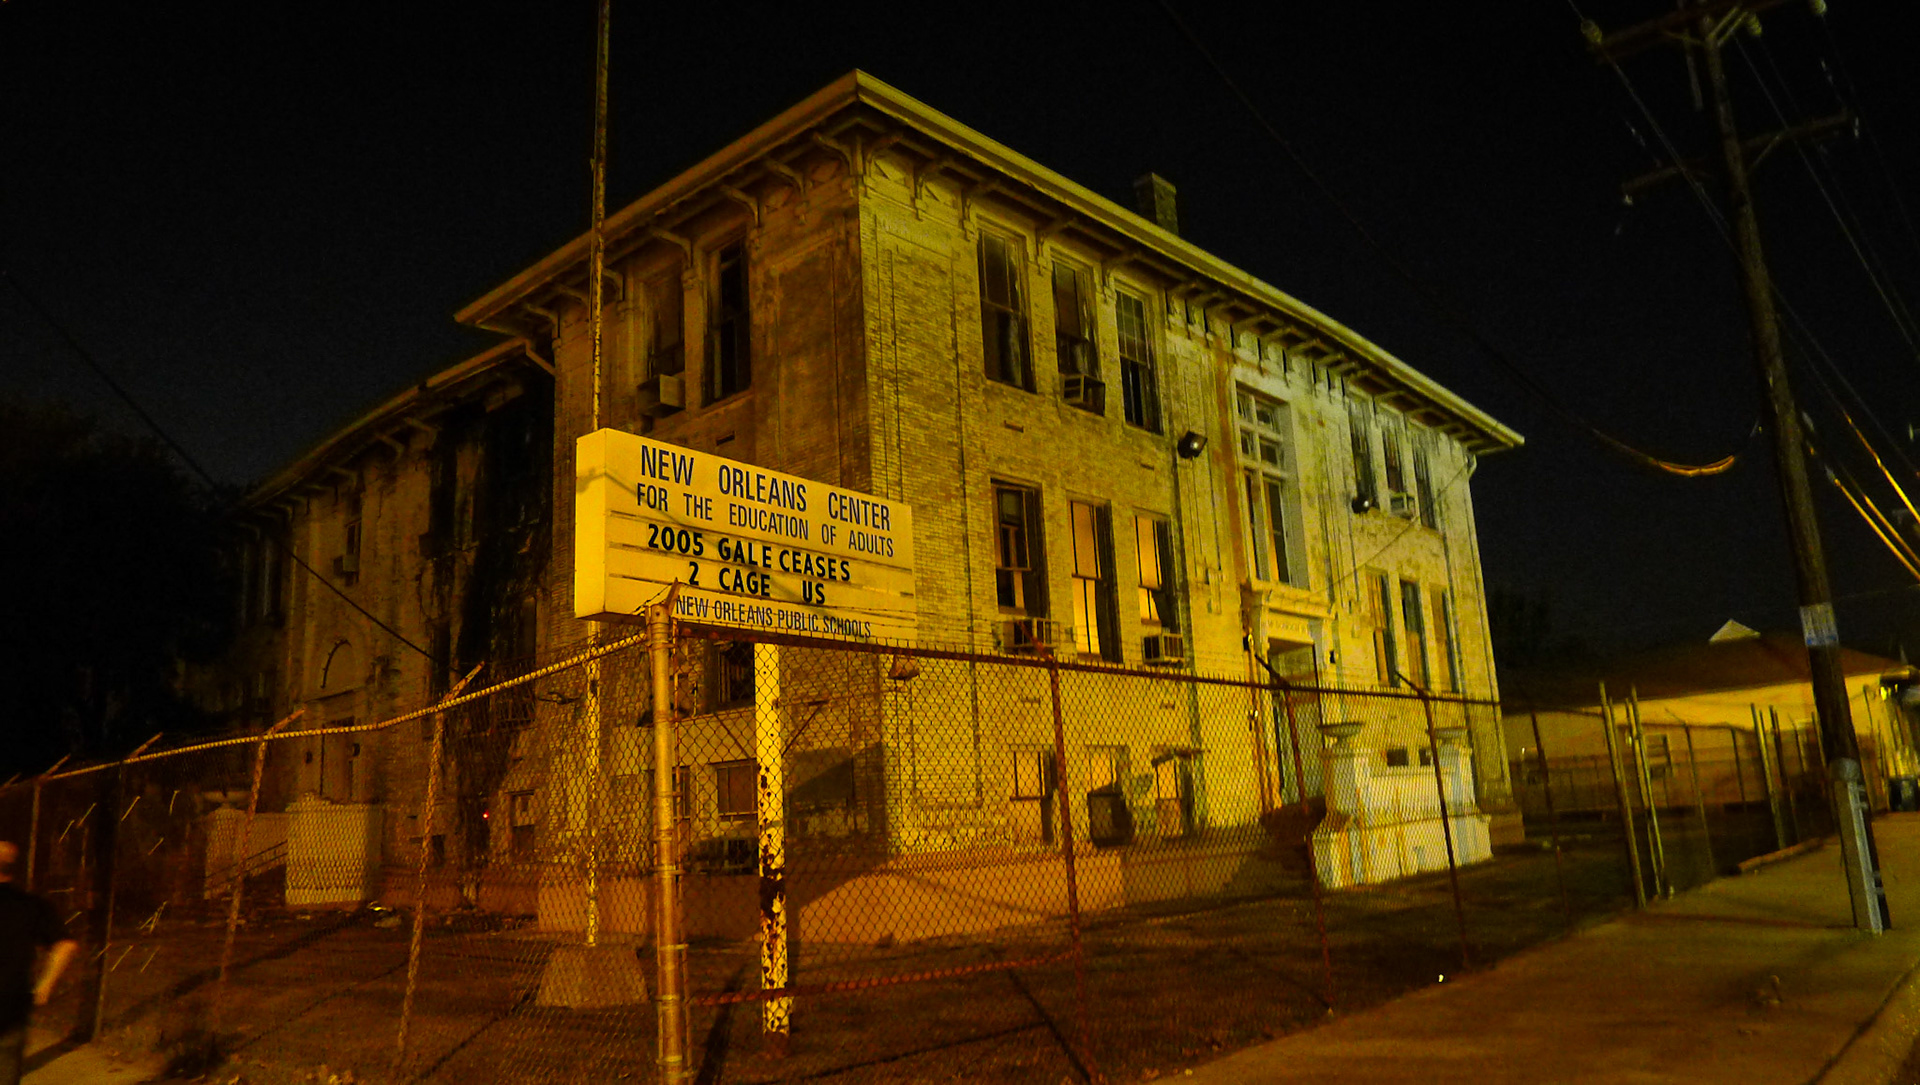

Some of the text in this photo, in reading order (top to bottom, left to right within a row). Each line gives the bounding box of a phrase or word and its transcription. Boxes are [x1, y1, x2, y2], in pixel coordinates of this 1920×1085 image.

[641, 445, 890, 531] NEW ORLEANS CENTER
[637, 483, 894, 557] FOR THE EDUCATION OF ADULTS
[648, 524, 850, 581] 2005 GALE CEASES
[689, 561, 825, 604] 2 CAGE US
[676, 595, 870, 638] NEW ORLEANS PUBLIC SCHOOLS
